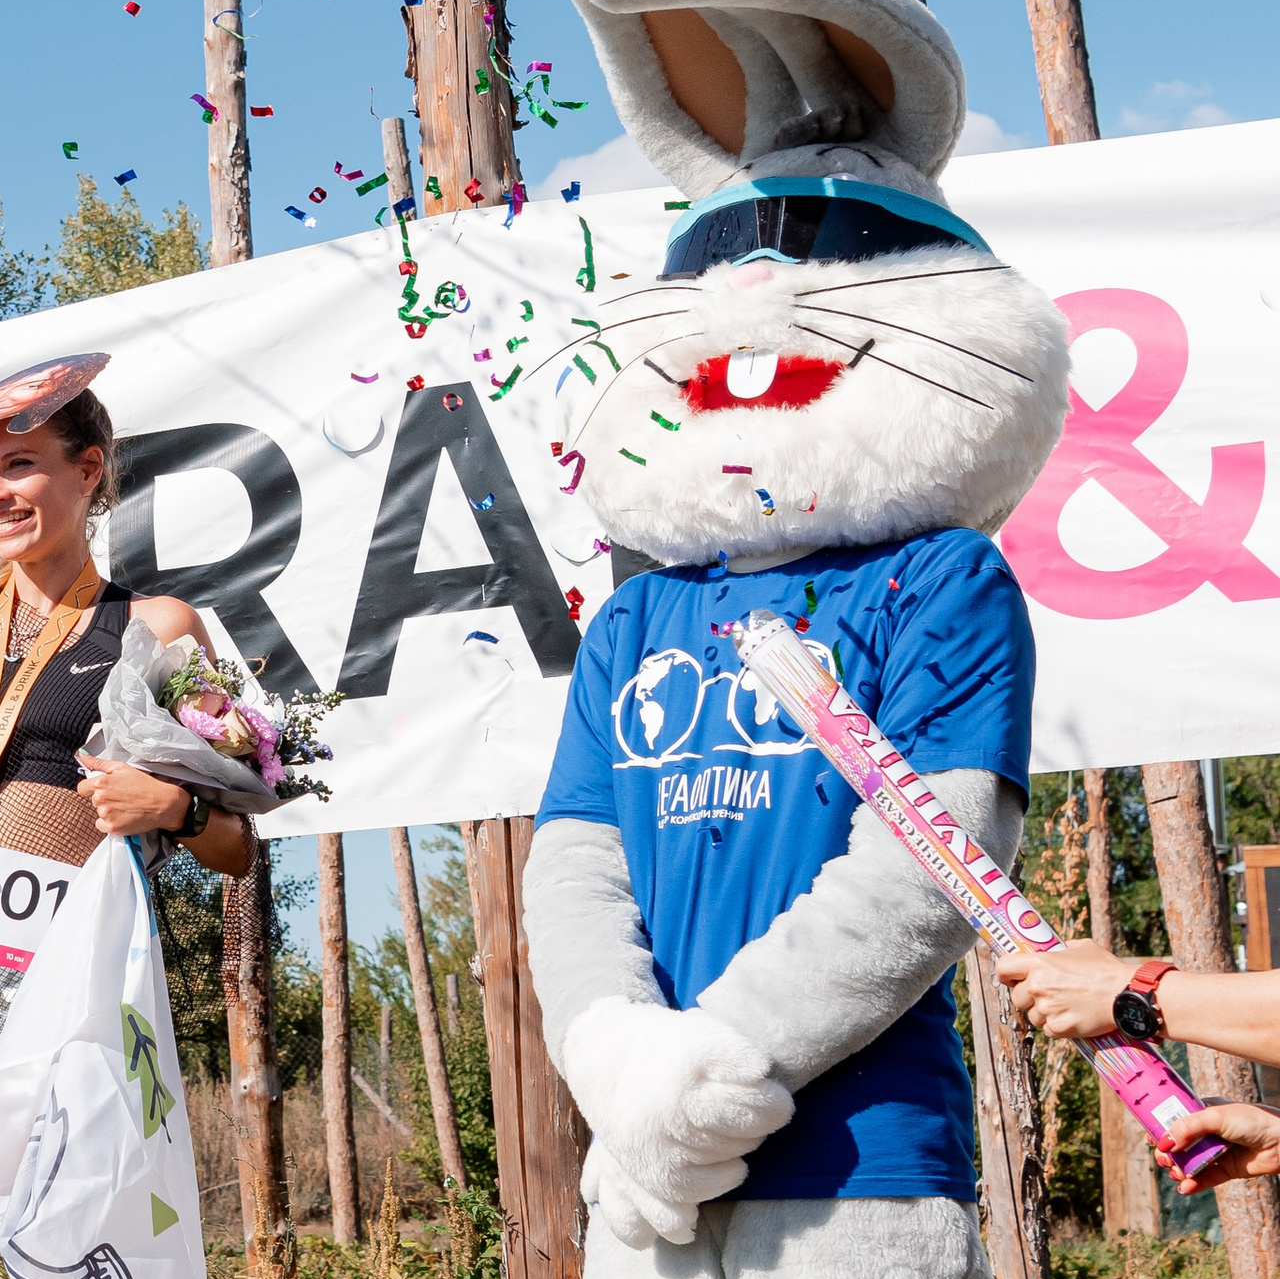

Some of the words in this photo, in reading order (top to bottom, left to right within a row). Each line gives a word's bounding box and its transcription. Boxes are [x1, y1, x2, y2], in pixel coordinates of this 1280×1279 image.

[1001, 287, 1280, 620] &
[14, 659, 41, 692] DRINK
[657, 766, 771, 817] ЕГАОПТИКА
[6, 952, 14, 960] 10
